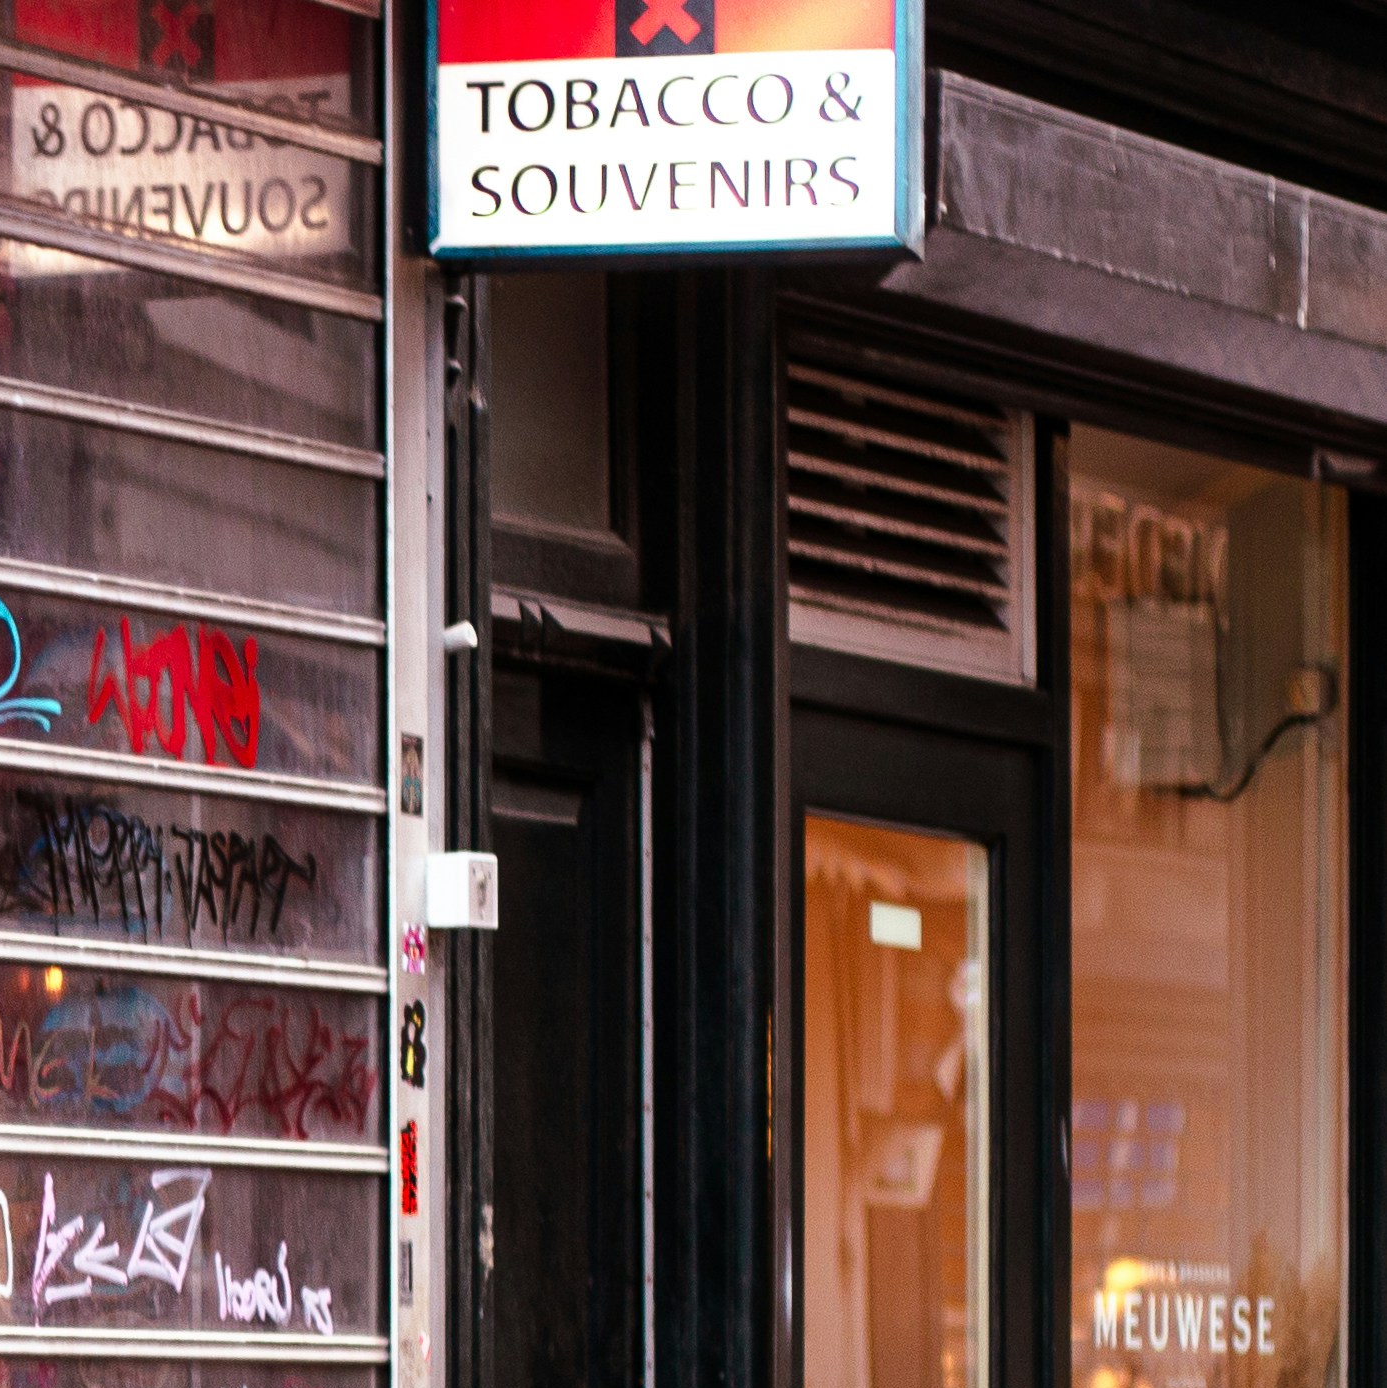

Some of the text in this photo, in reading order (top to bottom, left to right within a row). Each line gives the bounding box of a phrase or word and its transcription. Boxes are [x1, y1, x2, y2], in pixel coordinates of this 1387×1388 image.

[466, 70, 865, 134] TOBACCO &
[470, 155, 862, 219] SOUVENIRS
[1093, 1291, 1276, 1356] MEUWESE
